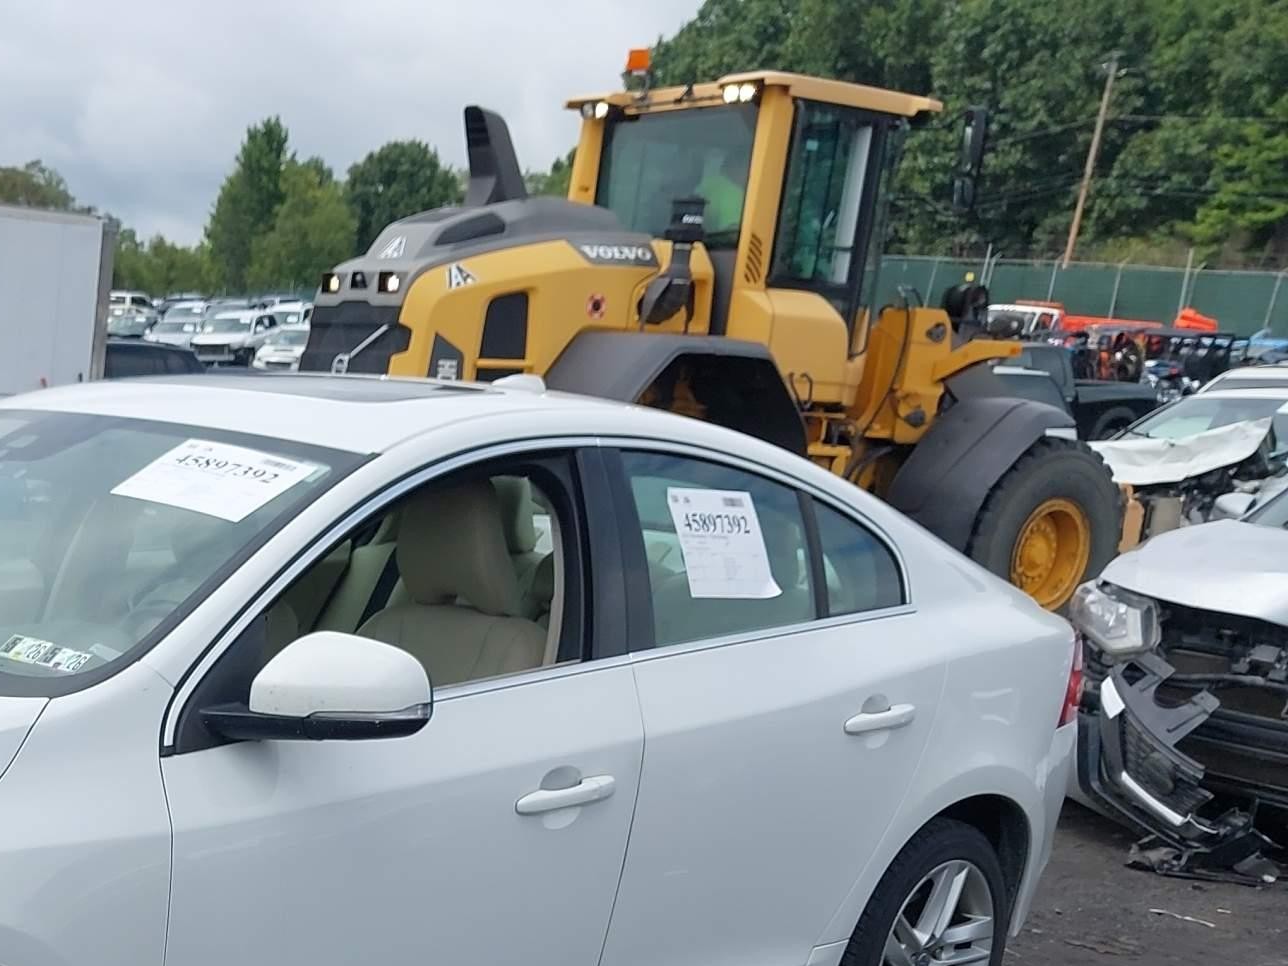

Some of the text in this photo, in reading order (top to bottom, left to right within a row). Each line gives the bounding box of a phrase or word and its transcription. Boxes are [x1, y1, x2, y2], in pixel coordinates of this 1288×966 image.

[581, 245, 652, 261] VOLVO
[176, 455, 279, 483] 45897392
[685, 513, 751, 534] 45897392
